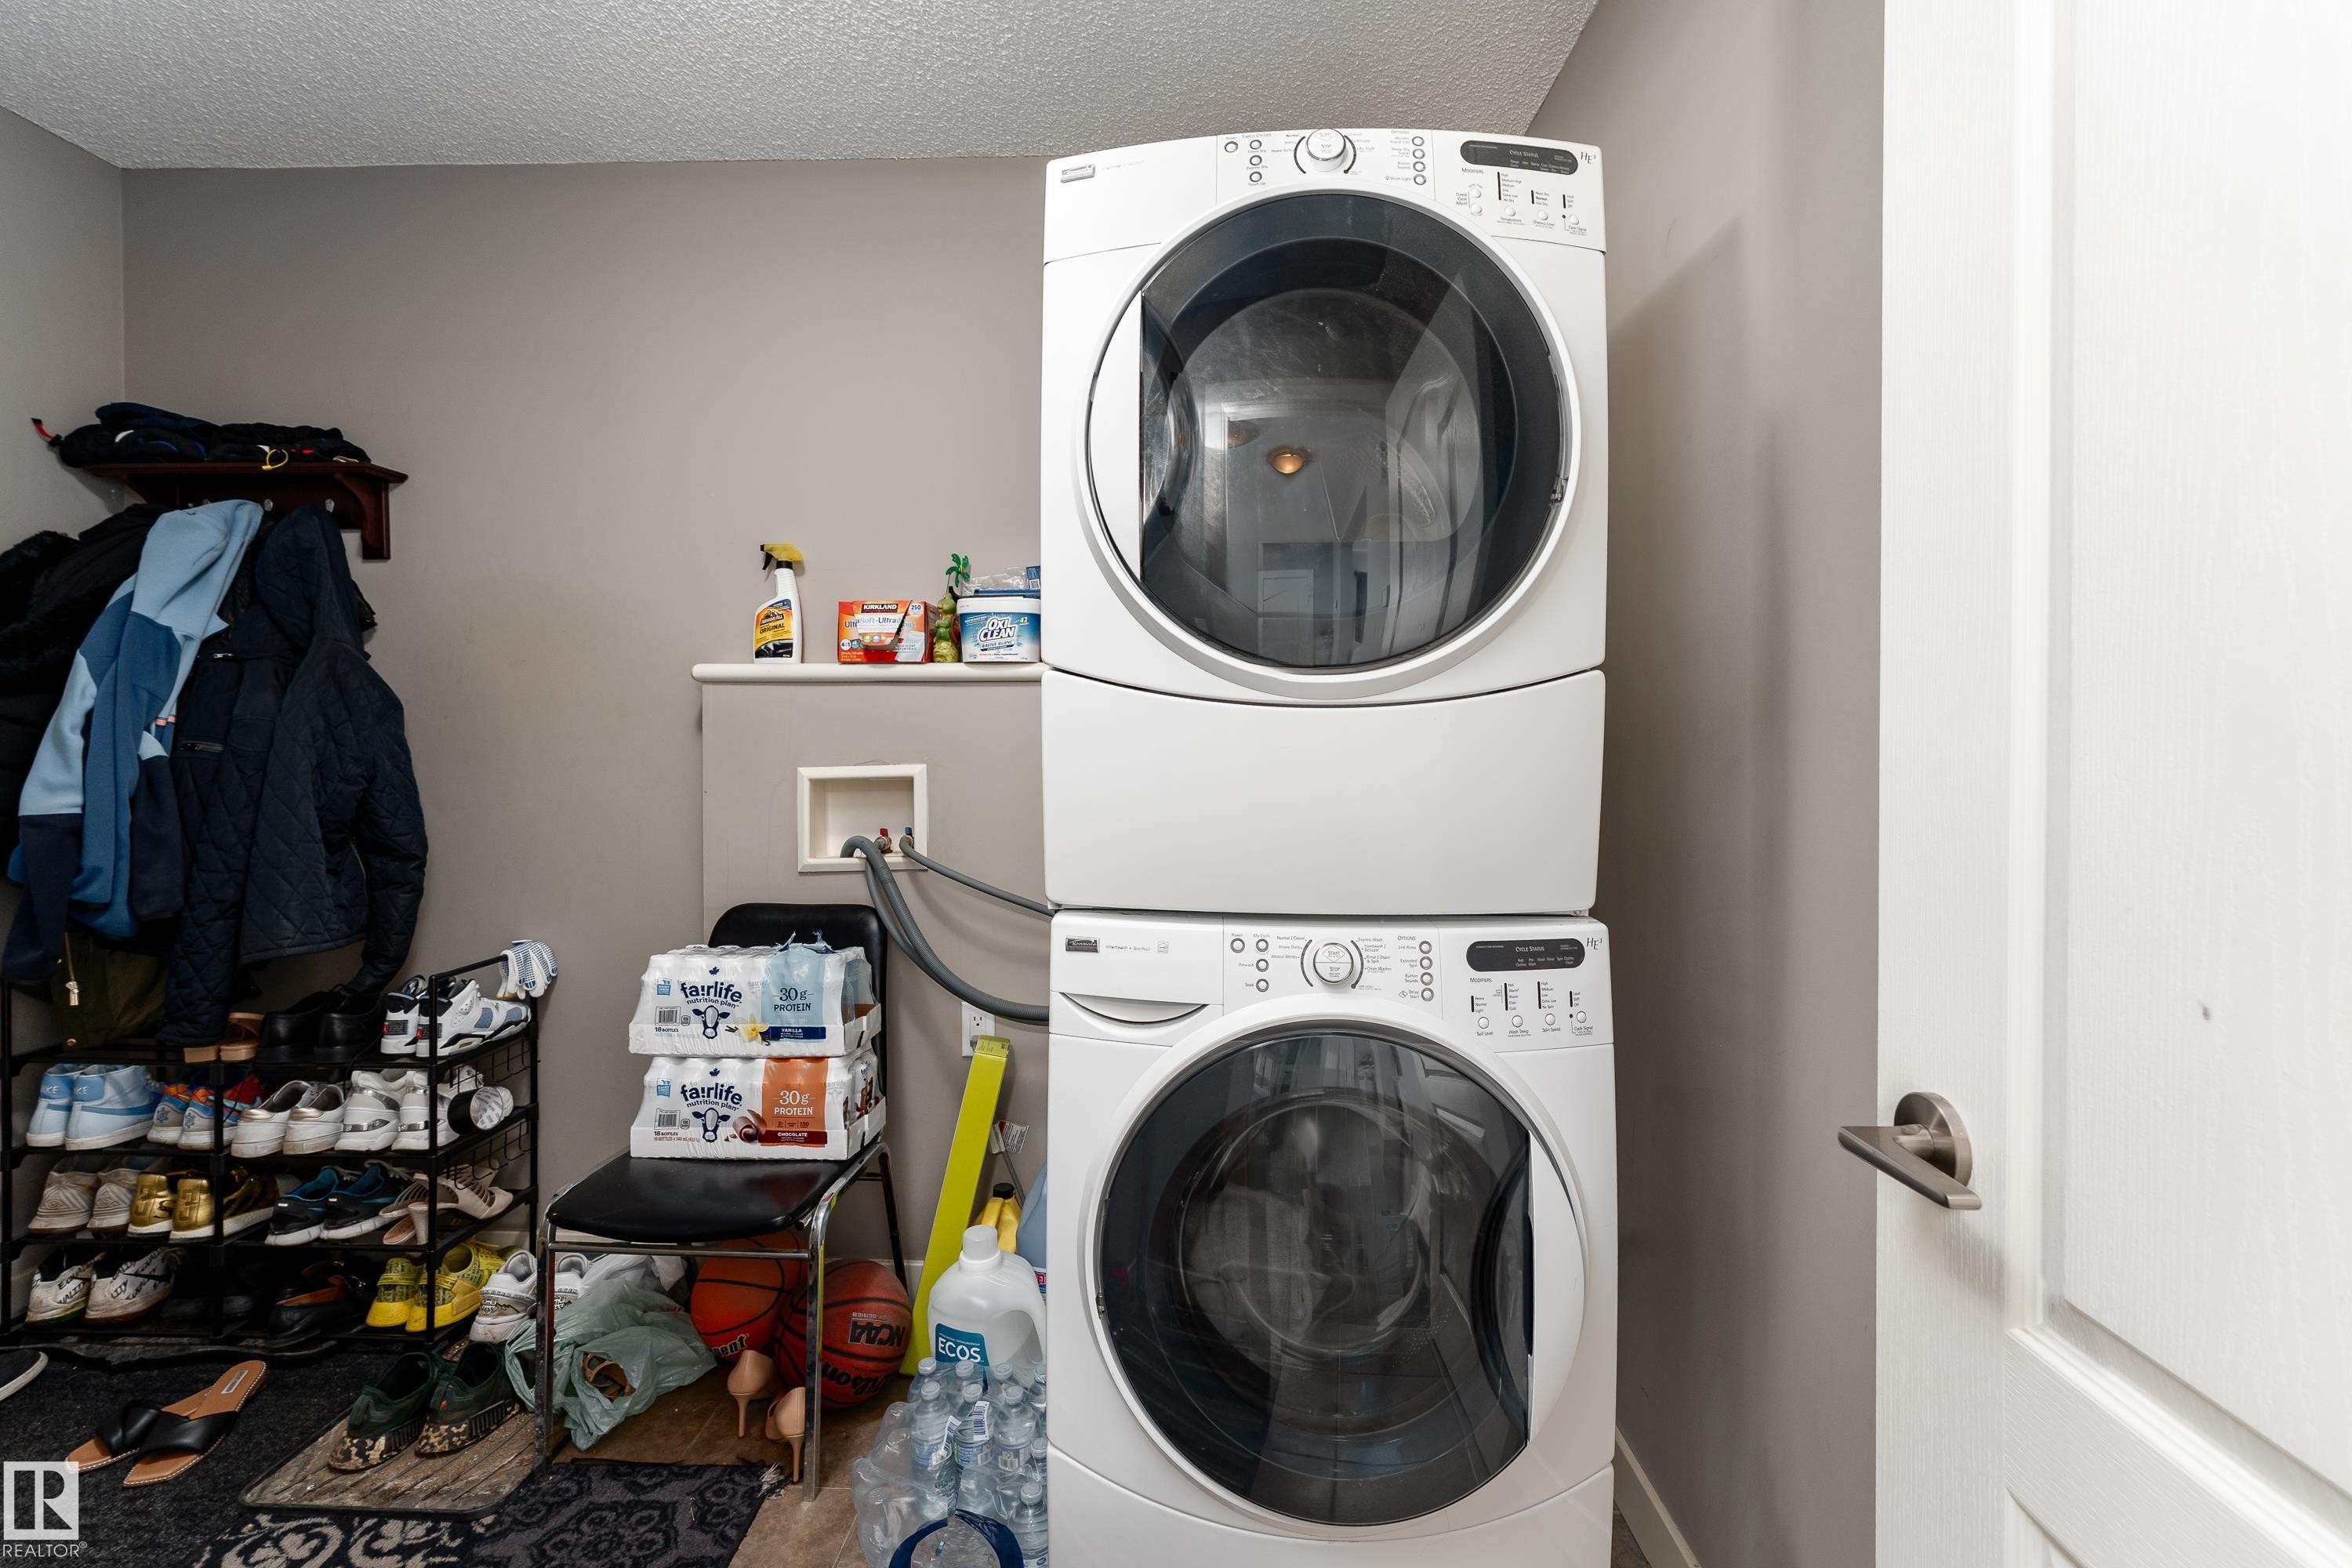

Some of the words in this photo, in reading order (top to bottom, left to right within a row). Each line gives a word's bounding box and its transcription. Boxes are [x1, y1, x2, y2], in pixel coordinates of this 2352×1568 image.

[760, 623, 785, 634] ORIGINAL
[988, 617, 1010, 631] OXI
[979, 626, 1016, 642] CLEAN
[779, 987, 798, 1001] 30
[800, 989, 808, 1000] g
[720, 1000, 737, 1009] plan
[779, 1091, 800, 1105] 30
[801, 1093, 810, 1105] g
[687, 1099, 720, 1108] nutrition
[721, 1102, 739, 1112] plan
[774, 1107, 813, 1116] PROTEIN
[849, 1321, 906, 1347] NCAA
[938, 1337, 981, 1363] ECOS
